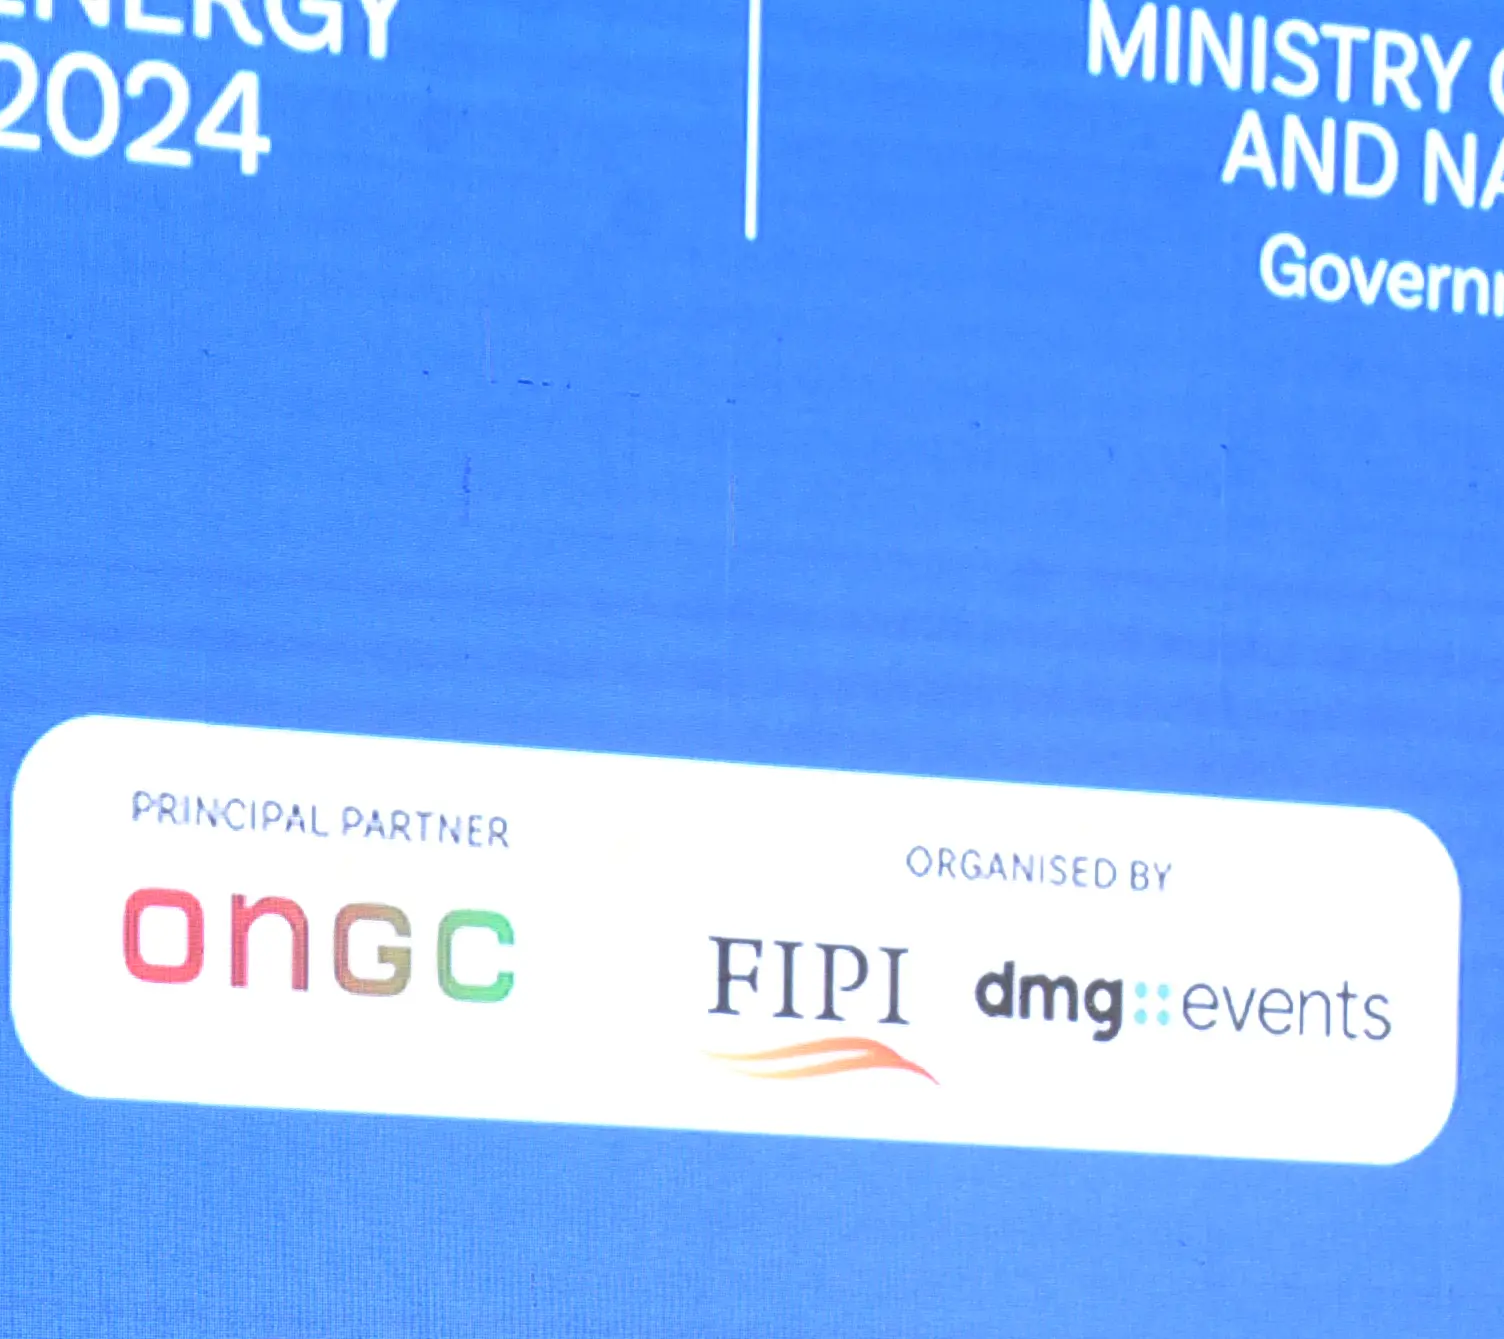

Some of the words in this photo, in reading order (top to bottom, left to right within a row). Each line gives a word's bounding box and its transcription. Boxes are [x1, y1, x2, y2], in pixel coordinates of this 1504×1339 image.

[1088, 0, 1472, 111] MINISTRY
[1223, 111, 1399, 197] AND
[131, 789, 330, 838] PRINCIPAL
[342, 805, 510, 849] PARTNER
[905, 845, 1118, 889] ORGANISED
[1130, 859, 1173, 892] BY
[707, 935, 911, 1026] FIPI
